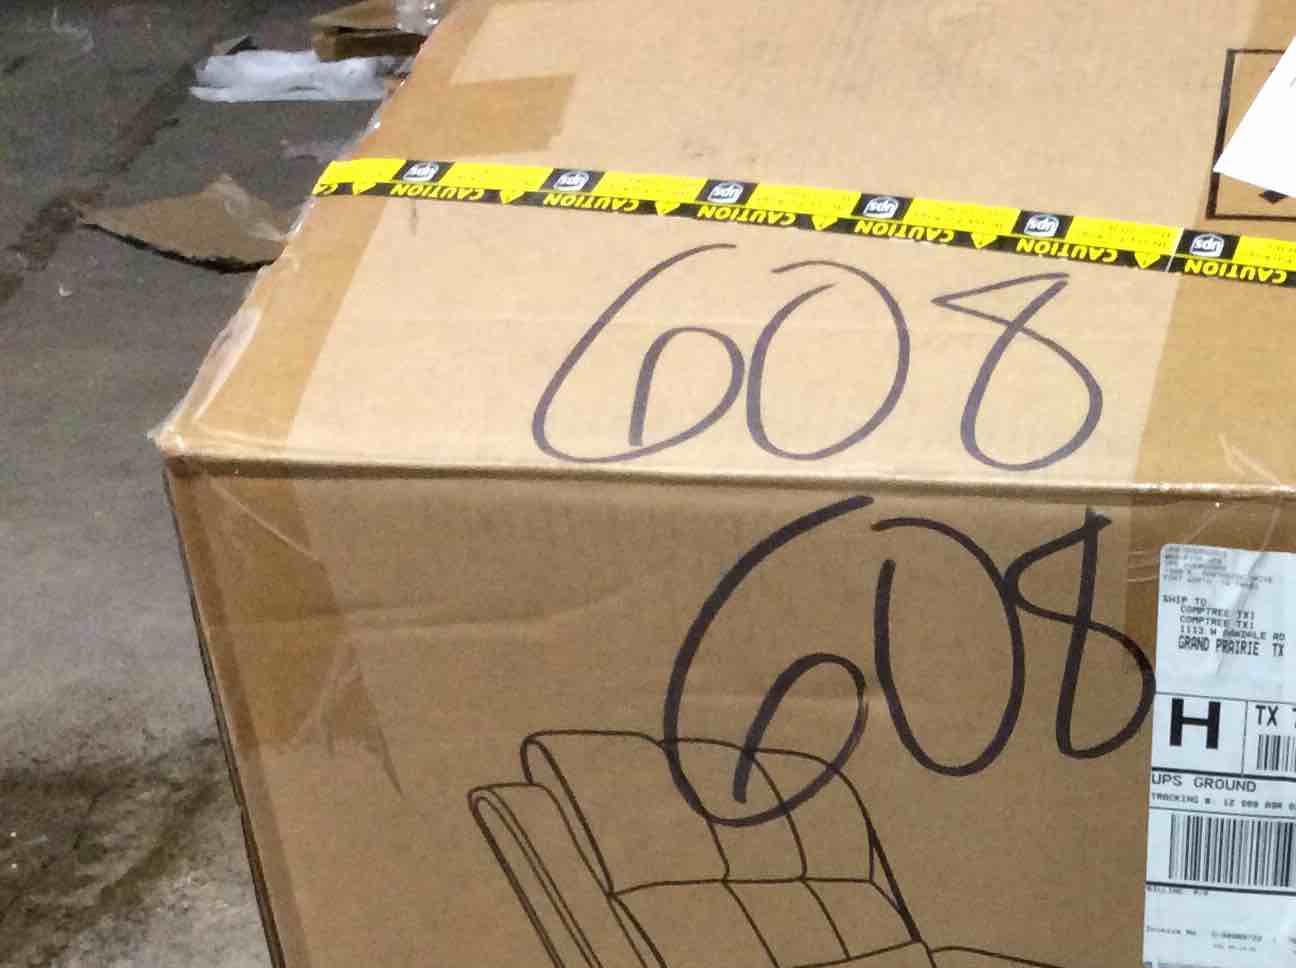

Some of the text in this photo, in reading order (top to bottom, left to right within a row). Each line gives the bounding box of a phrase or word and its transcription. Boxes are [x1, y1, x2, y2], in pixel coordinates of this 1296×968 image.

[390, 185, 484, 201] CAUTION
[544, 192, 640, 213] CAUTION
[697, 205, 797, 227] CAUTION
[854, 219, 955, 244] CAUTION
[1016, 237, 1119, 263] CAUTION
[1184, 258, 1289, 285] CAUTION
[532, 243, 1104, 472] 608
[1178, 635, 1210, 652] GRAND
[1215, 638, 1260, 657] PRAIRIE
[1272, 642, 1285, 658] TX
[664, 495, 1157, 828] 608
[1169, 697, 1221, 750] H
[1255, 704, 1279, 727] TX
[1151, 773, 1257, 794] UPS GROUND
